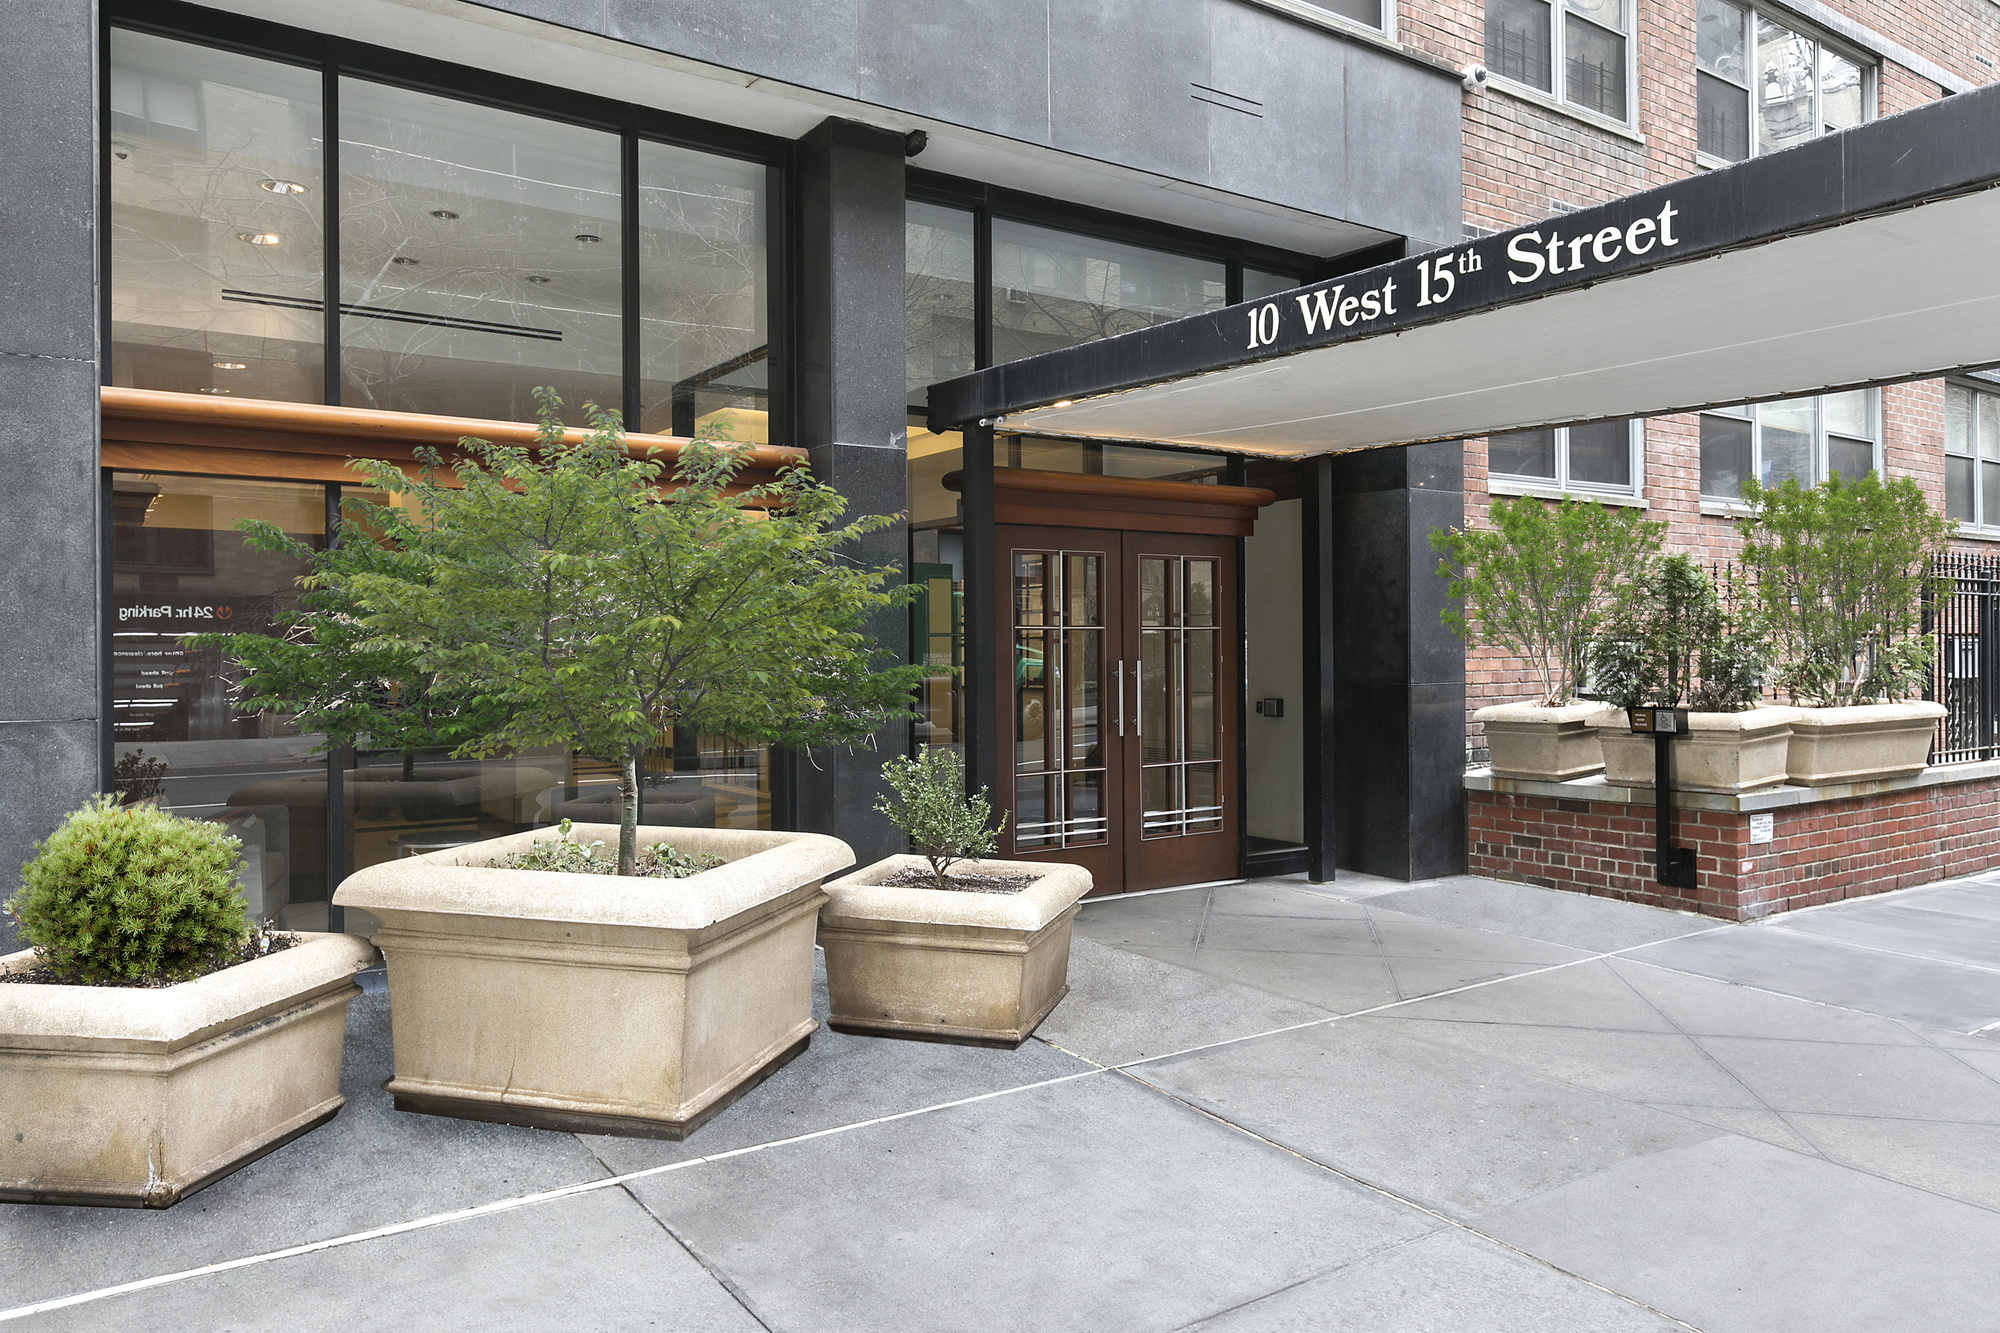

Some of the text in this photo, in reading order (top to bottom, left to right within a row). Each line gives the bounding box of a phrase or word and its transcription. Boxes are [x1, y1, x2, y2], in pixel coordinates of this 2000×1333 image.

[1247, 200, 1678, 350] 10 West 15th Street
